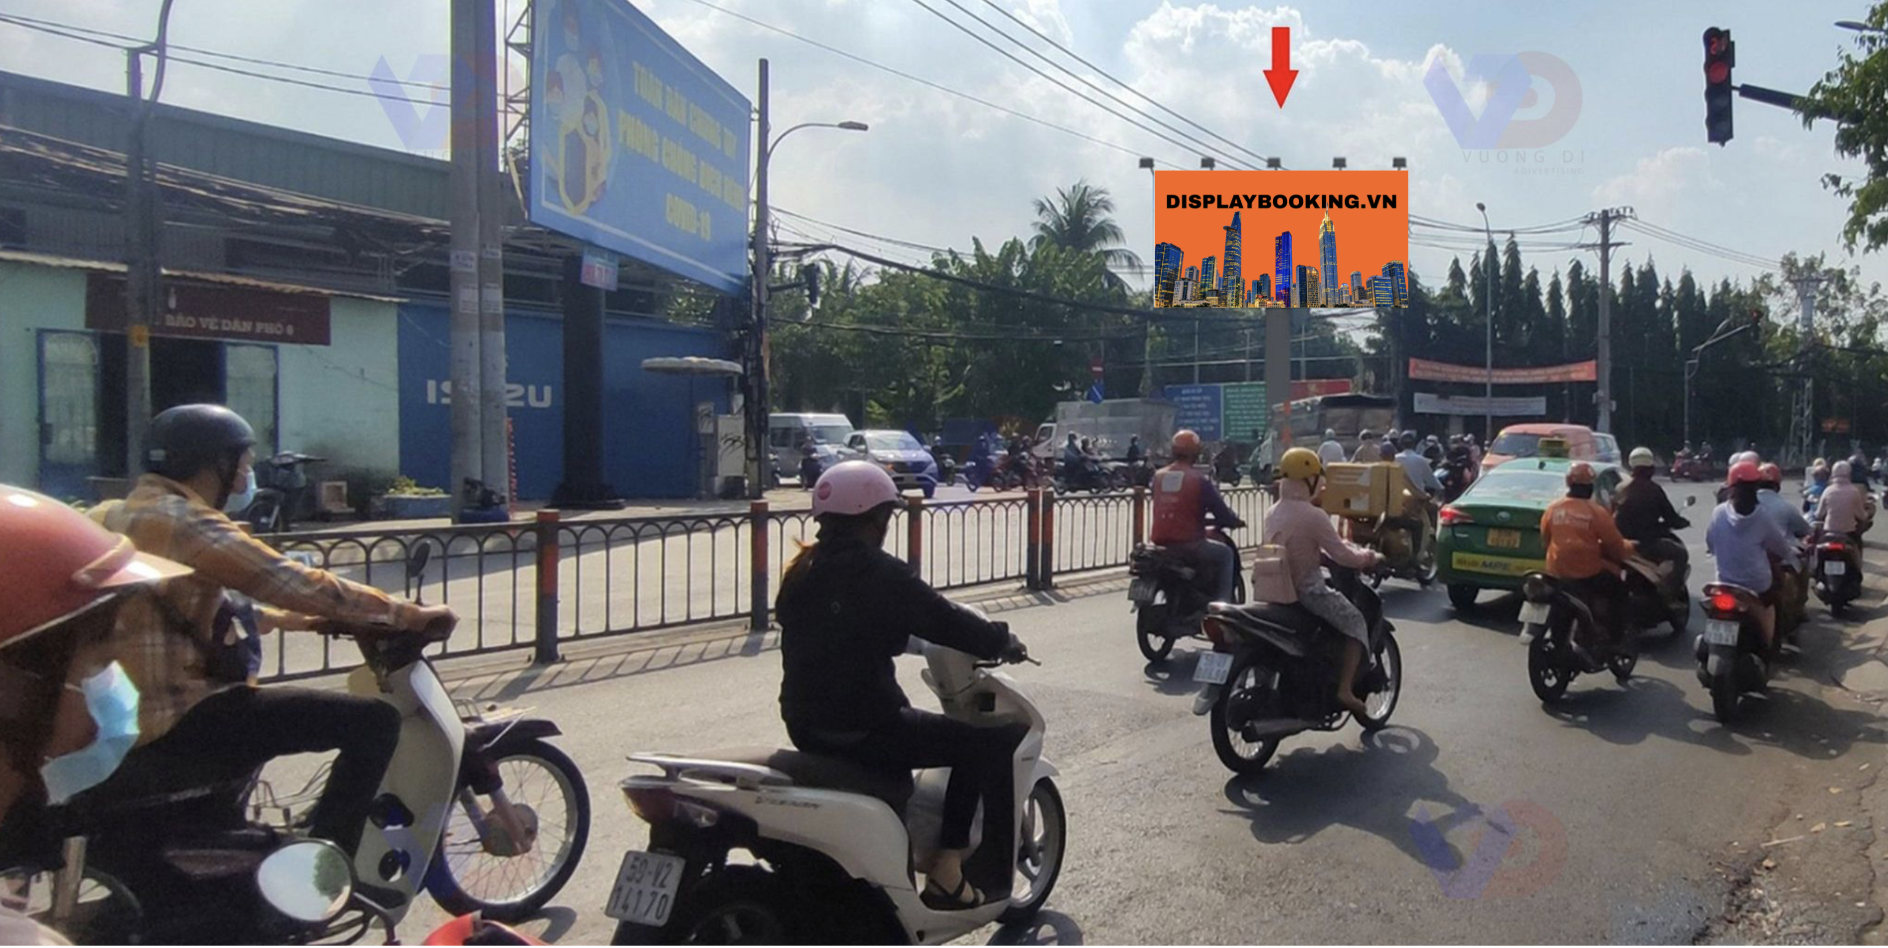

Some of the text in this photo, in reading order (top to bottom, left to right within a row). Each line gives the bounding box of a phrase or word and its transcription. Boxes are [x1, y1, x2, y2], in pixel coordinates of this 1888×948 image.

[1166, 194, 1397, 209] DISPLAYBOOKING.VN
[427, 380, 551, 408] IZU
[613, 885, 669, 920] 14170
